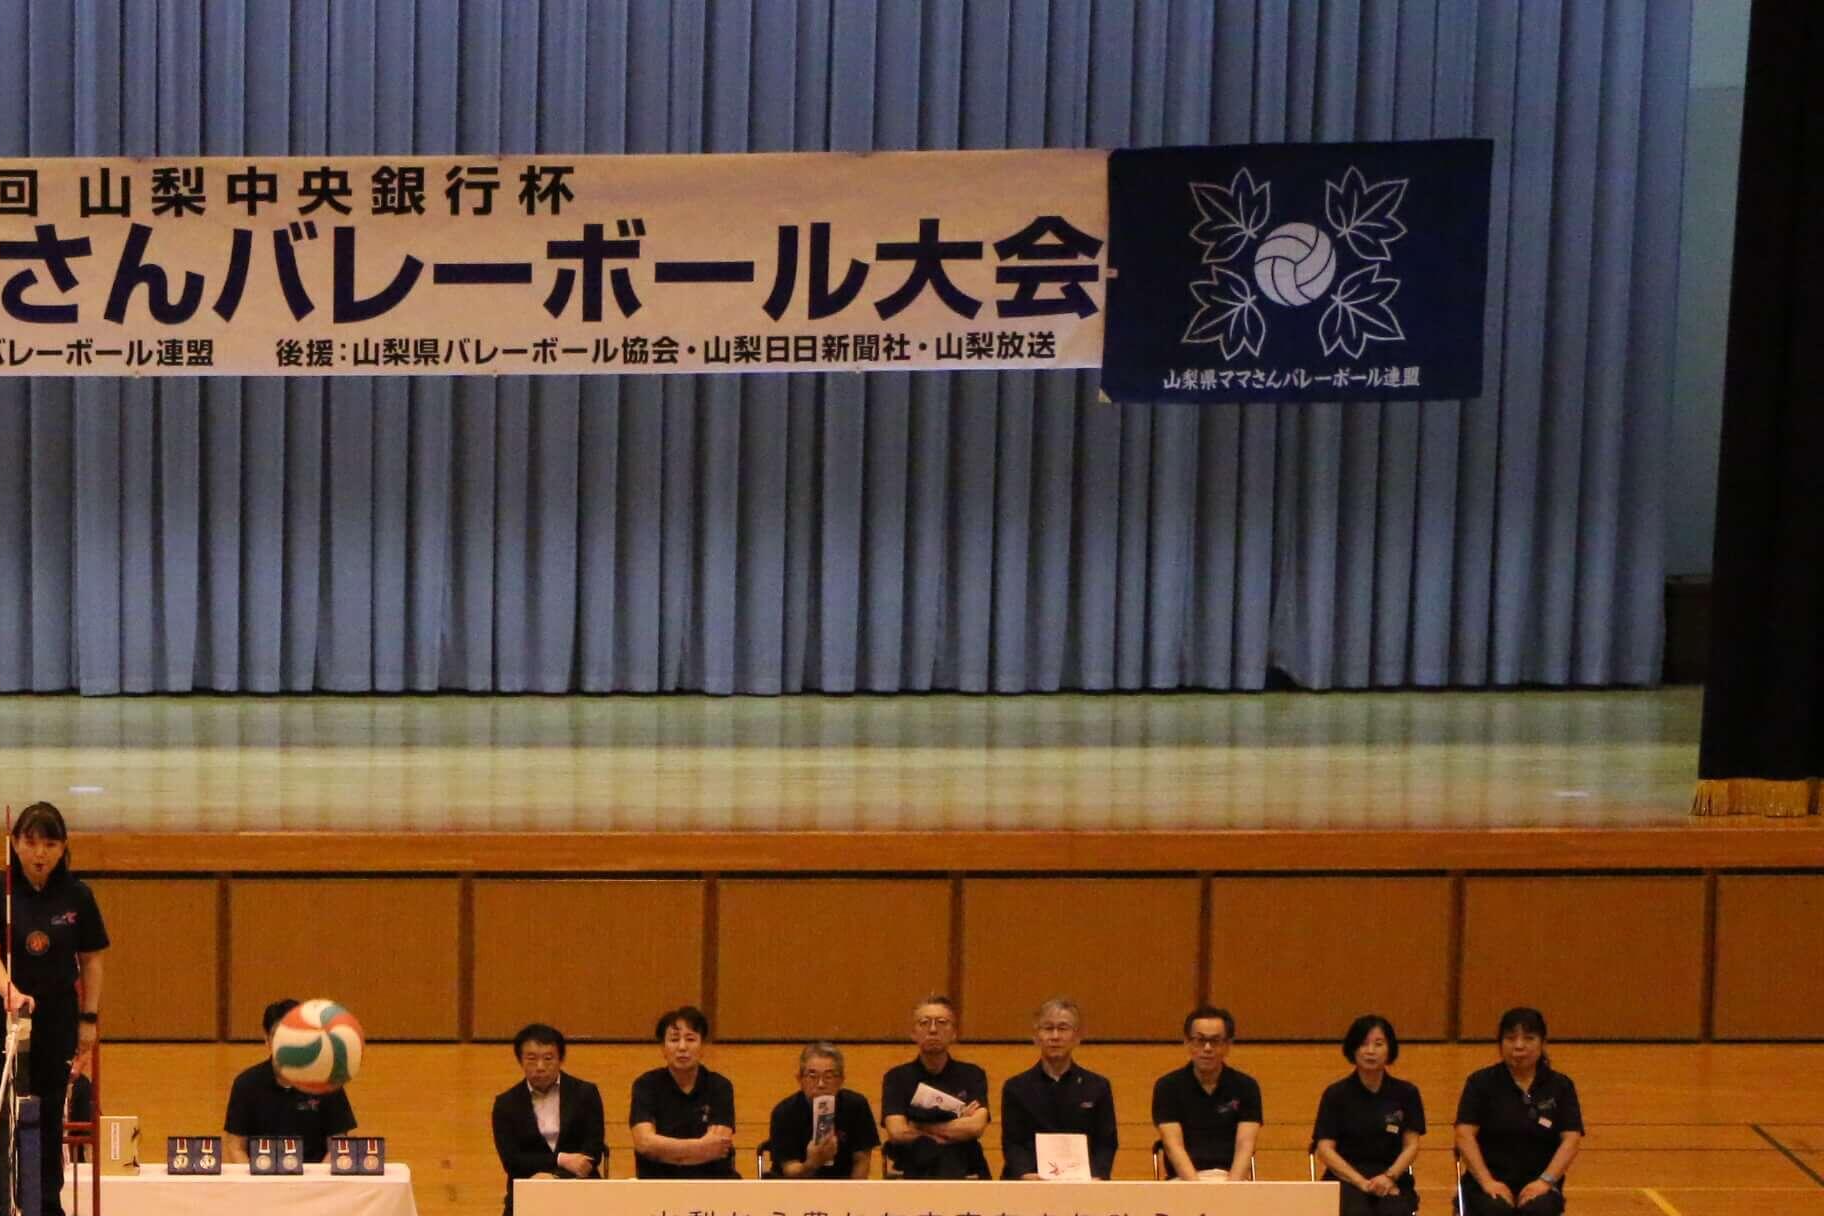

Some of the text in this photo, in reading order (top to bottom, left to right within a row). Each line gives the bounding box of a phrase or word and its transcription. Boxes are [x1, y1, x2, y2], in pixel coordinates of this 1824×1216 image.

[79, 164, 576, 219] 山梨中央銀行杯
[1162, 365, 1421, 391] 山梨県ママさんバレーボール連盟
